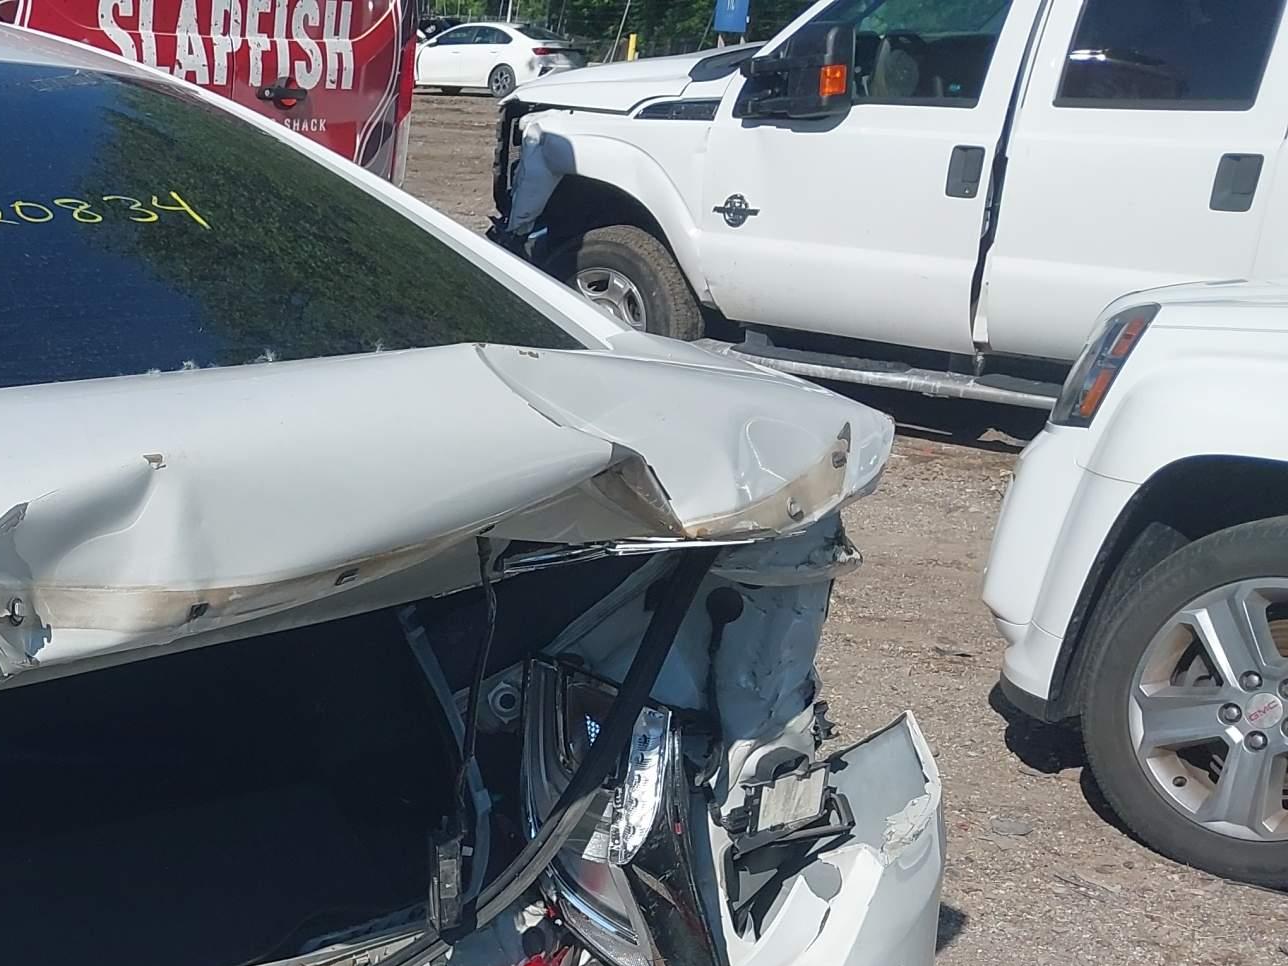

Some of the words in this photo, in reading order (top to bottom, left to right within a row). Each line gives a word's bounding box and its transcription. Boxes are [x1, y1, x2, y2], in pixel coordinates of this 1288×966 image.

[98, 0, 354, 90] SLAPFISH
[283, 118, 327, 132] SHACK
[1248, 700, 1280, 721] GMC
